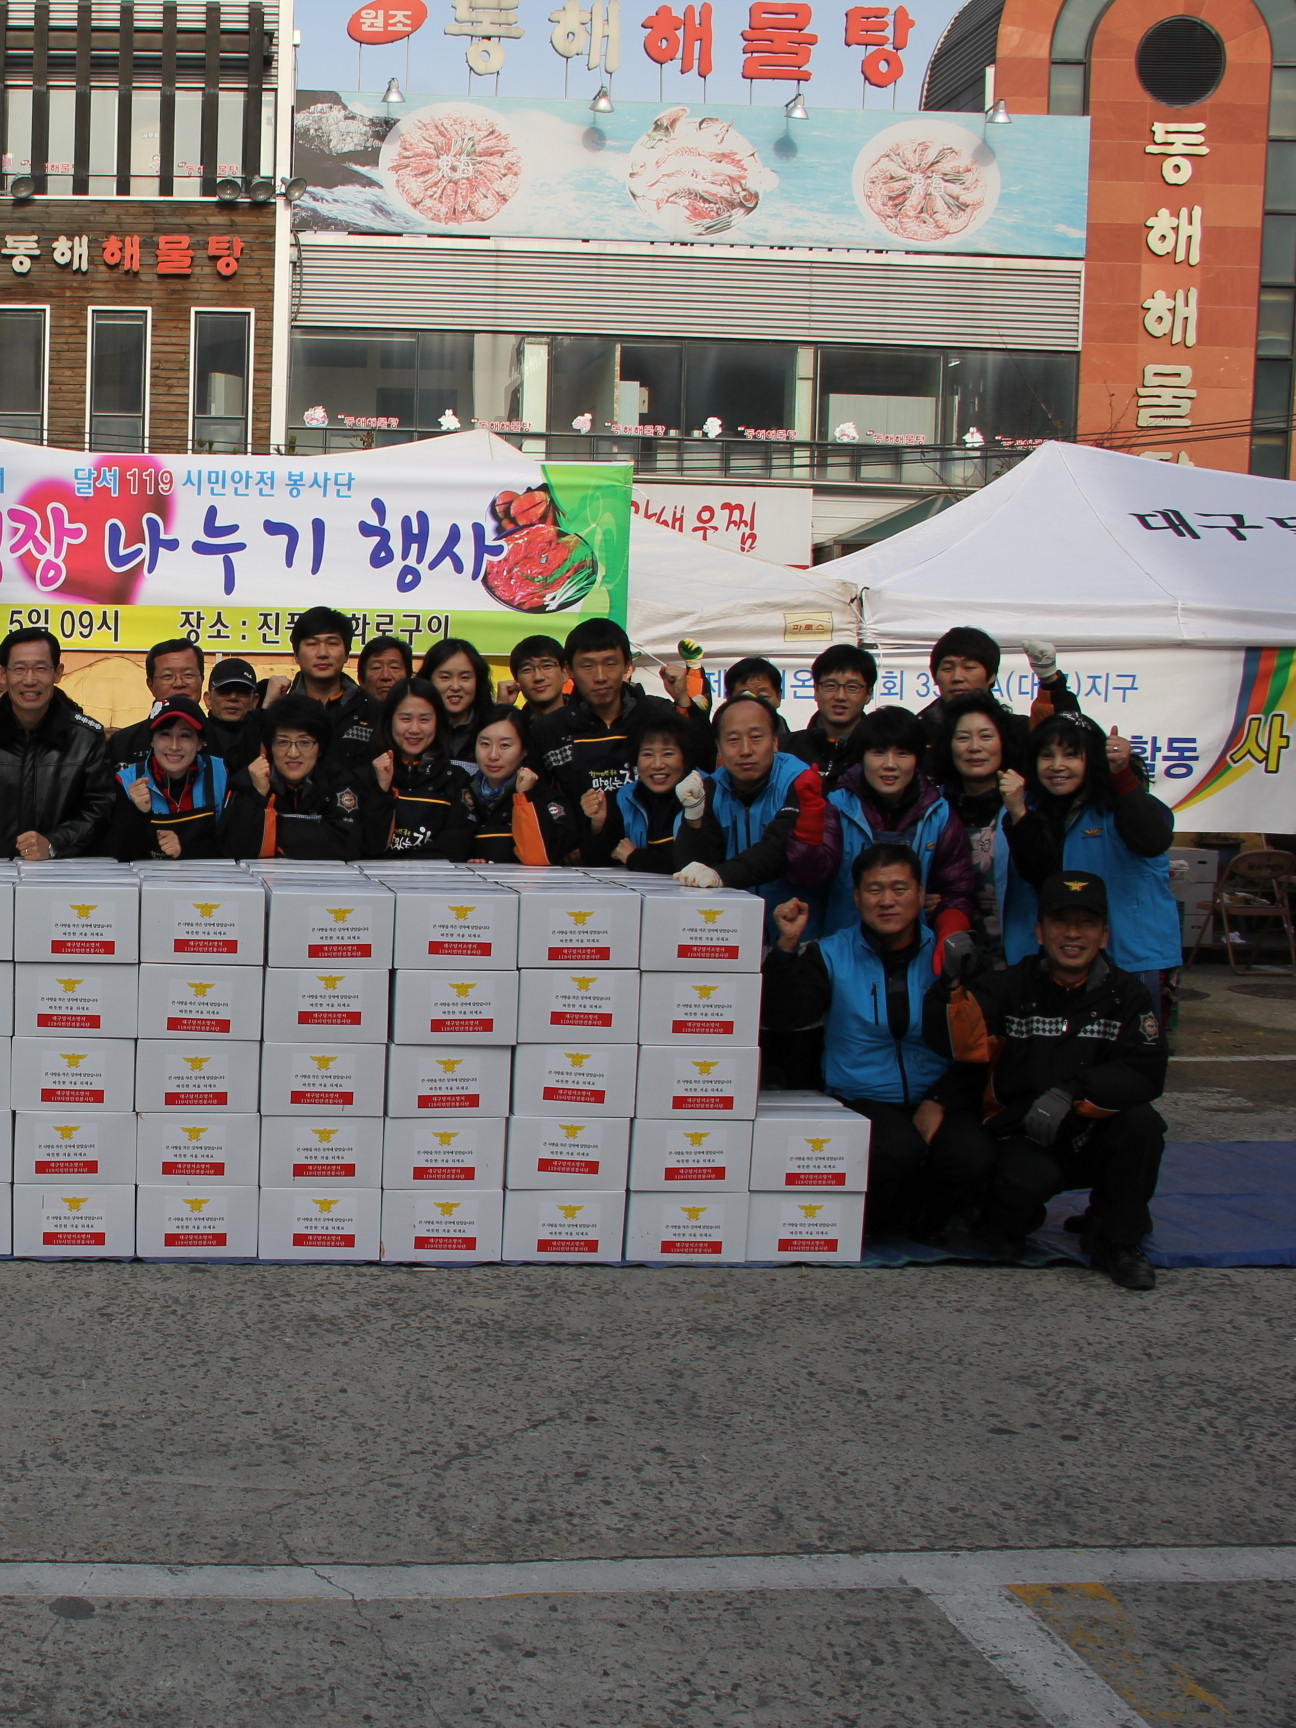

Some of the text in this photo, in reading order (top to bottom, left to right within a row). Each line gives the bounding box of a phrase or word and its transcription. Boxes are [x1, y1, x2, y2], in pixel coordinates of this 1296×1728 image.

[359, 0, 916, 89] 원조 동해해물탕
[1, 234, 245, 277] 동해해물탕
[1136, 121, 1210, 467] 동해해물
[73, 466, 356, 499] 달서 119 시민안전 봉사단
[106, 504, 327, 596] 나누기
[358, 497, 505, 593] 행사
[59, 609, 120, 643] 09시
[792, 623, 826, 632] 파로스
